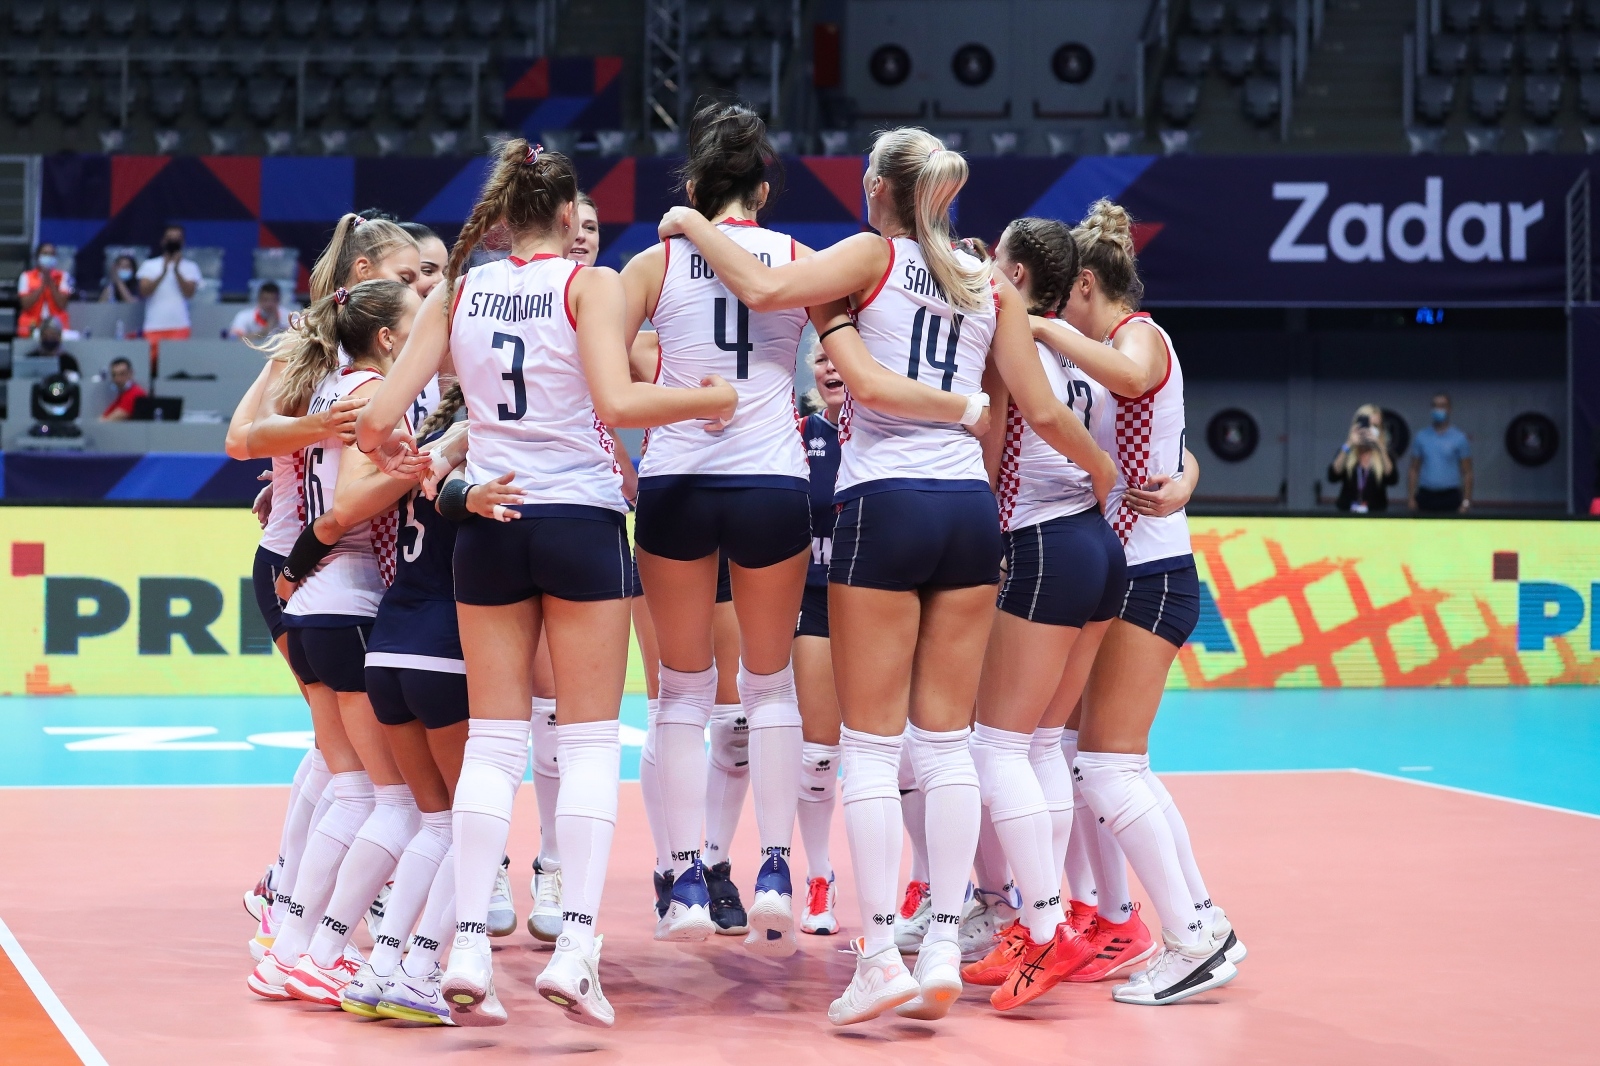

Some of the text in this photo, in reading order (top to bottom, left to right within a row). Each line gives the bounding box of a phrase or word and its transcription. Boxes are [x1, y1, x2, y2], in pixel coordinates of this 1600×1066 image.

[1268, 176, 1544, 263] Zadar
[468, 291, 553, 323] STRUNJAK
[714, 297, 754, 380] 4
[907, 305, 965, 393] 14
[491, 331, 528, 421] 3
